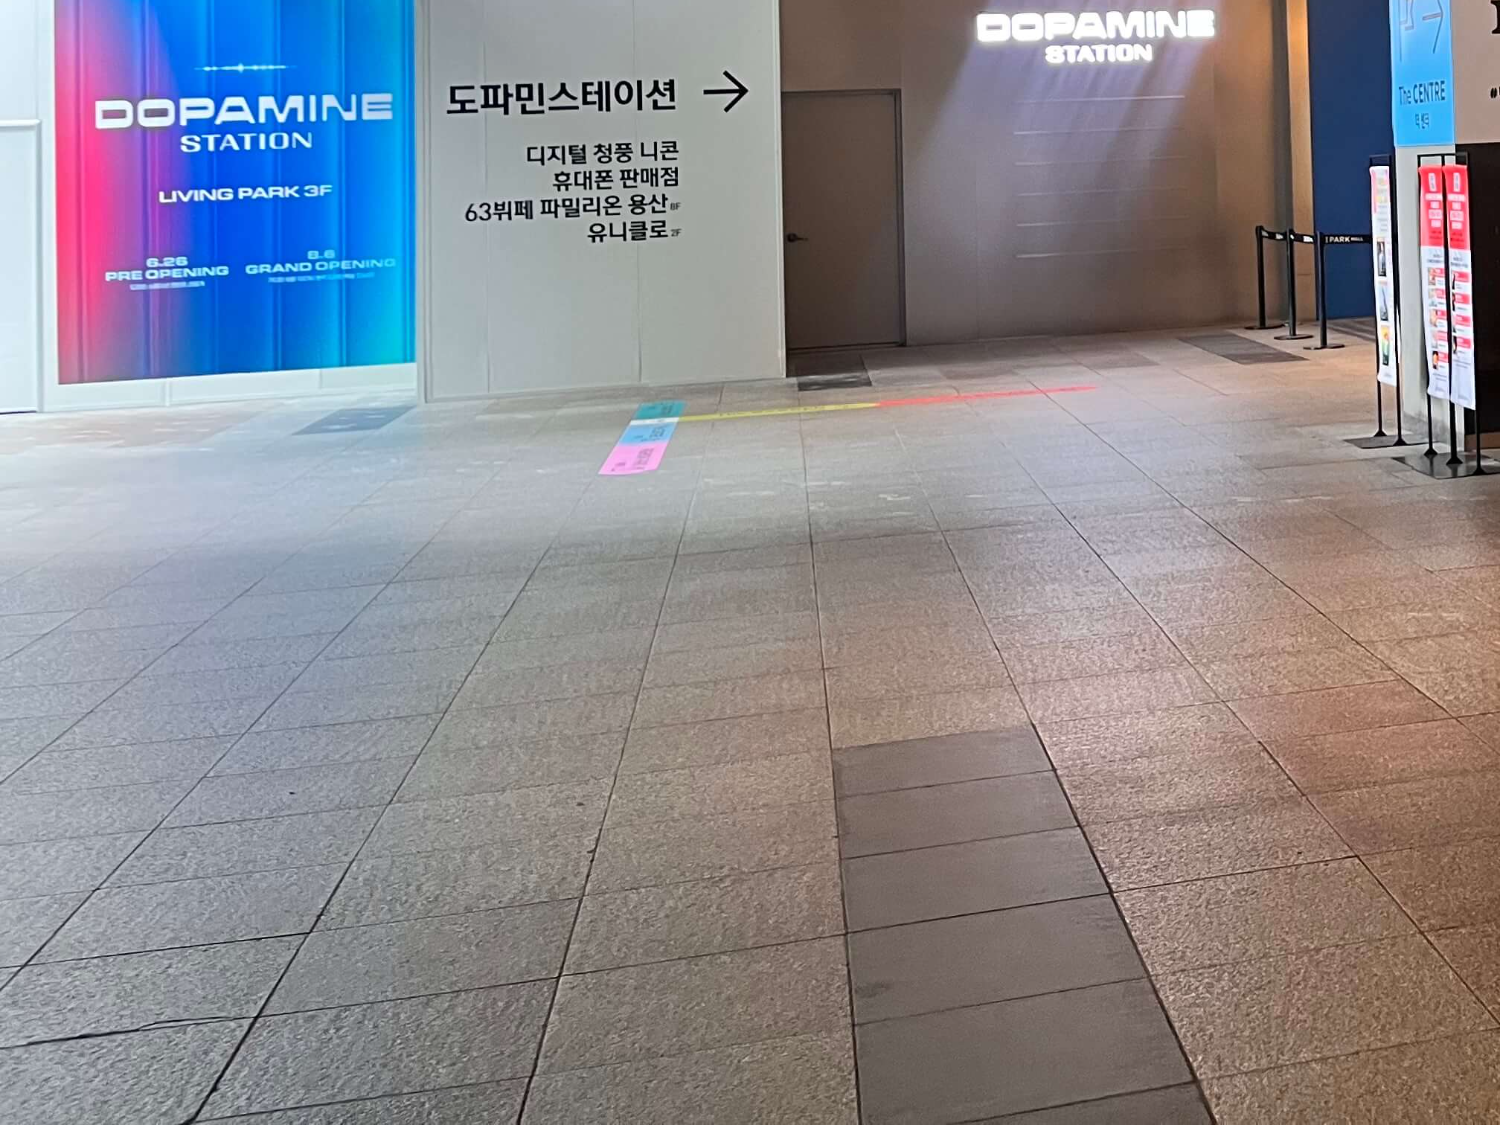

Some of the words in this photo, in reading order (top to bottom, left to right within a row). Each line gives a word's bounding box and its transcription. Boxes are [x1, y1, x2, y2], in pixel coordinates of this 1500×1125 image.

[976, 9, 1216, 43] DOPAMINE
[1044, 43, 1154, 64] STATION
[446, 78, 677, 116] 도파민스테이션
[1398, 86, 1412, 106] The
[1413, 79, 1446, 104] CENTRE
[94, 92, 394, 130] DOPAMINE
[179, 131, 313, 153] STATION
[526, 143, 587, 166] 디지털
[593, 142, 634, 164] 청풍
[640, 140, 680, 162] 니콘
[552, 169, 615, 192] 휴대폰
[619, 166, 680, 189] 판매점
[158, 186, 235, 204] LIVING
[238, 185, 301, 200] PARK
[303, 184, 333, 197] 3F
[464, 199, 535, 223] 63뷔페
[539, 195, 623, 220] 파밀리온
[627, 193, 669, 216] 용산
[587, 219, 669, 244] 유니클로
[105, 270, 143, 281] PRE
[145, 265, 230, 280] OPENING
[145, 256, 189, 268] 6.26
[245, 262, 313, 275] GRAND
[315, 257, 397, 271] OPENING
